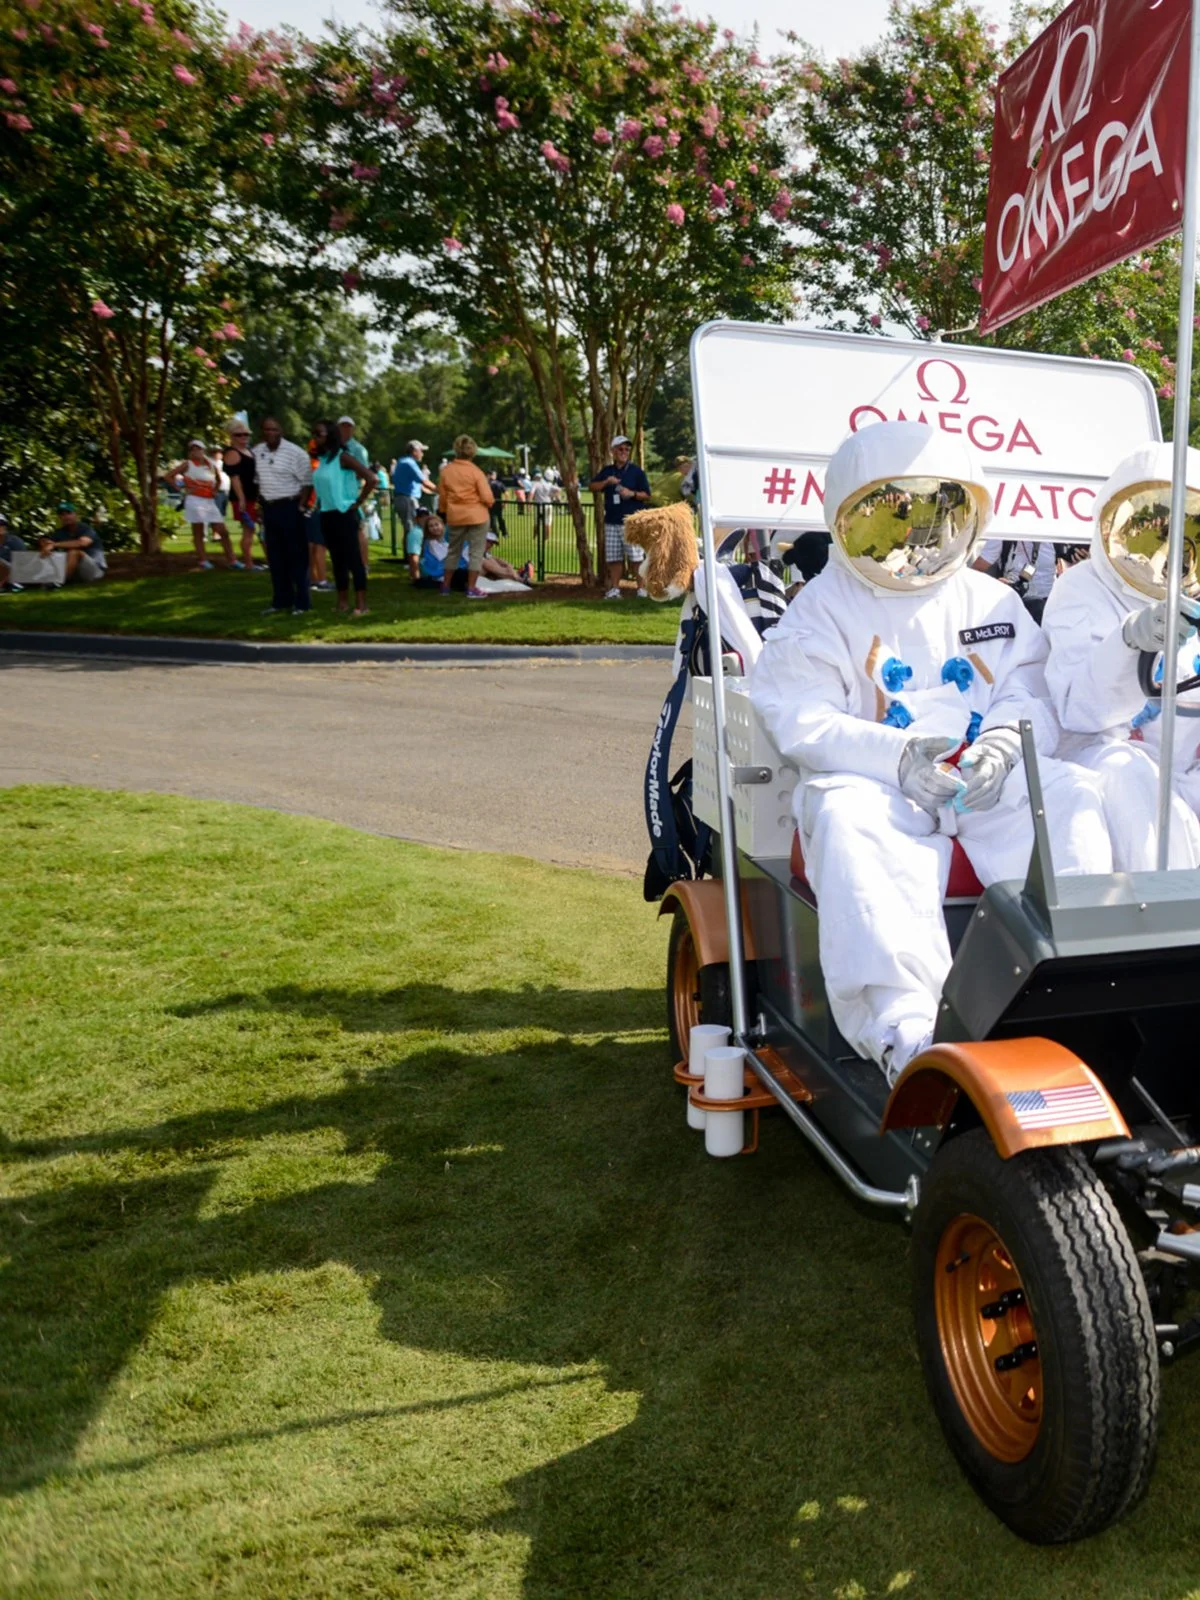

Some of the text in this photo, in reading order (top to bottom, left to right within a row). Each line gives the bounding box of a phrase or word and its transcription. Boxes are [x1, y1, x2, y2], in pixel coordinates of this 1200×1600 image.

[997, 99, 1163, 273] OMEGA
[963, 625, 1010, 642] R. McILROY
[648, 703, 672, 838] TaylorMade
